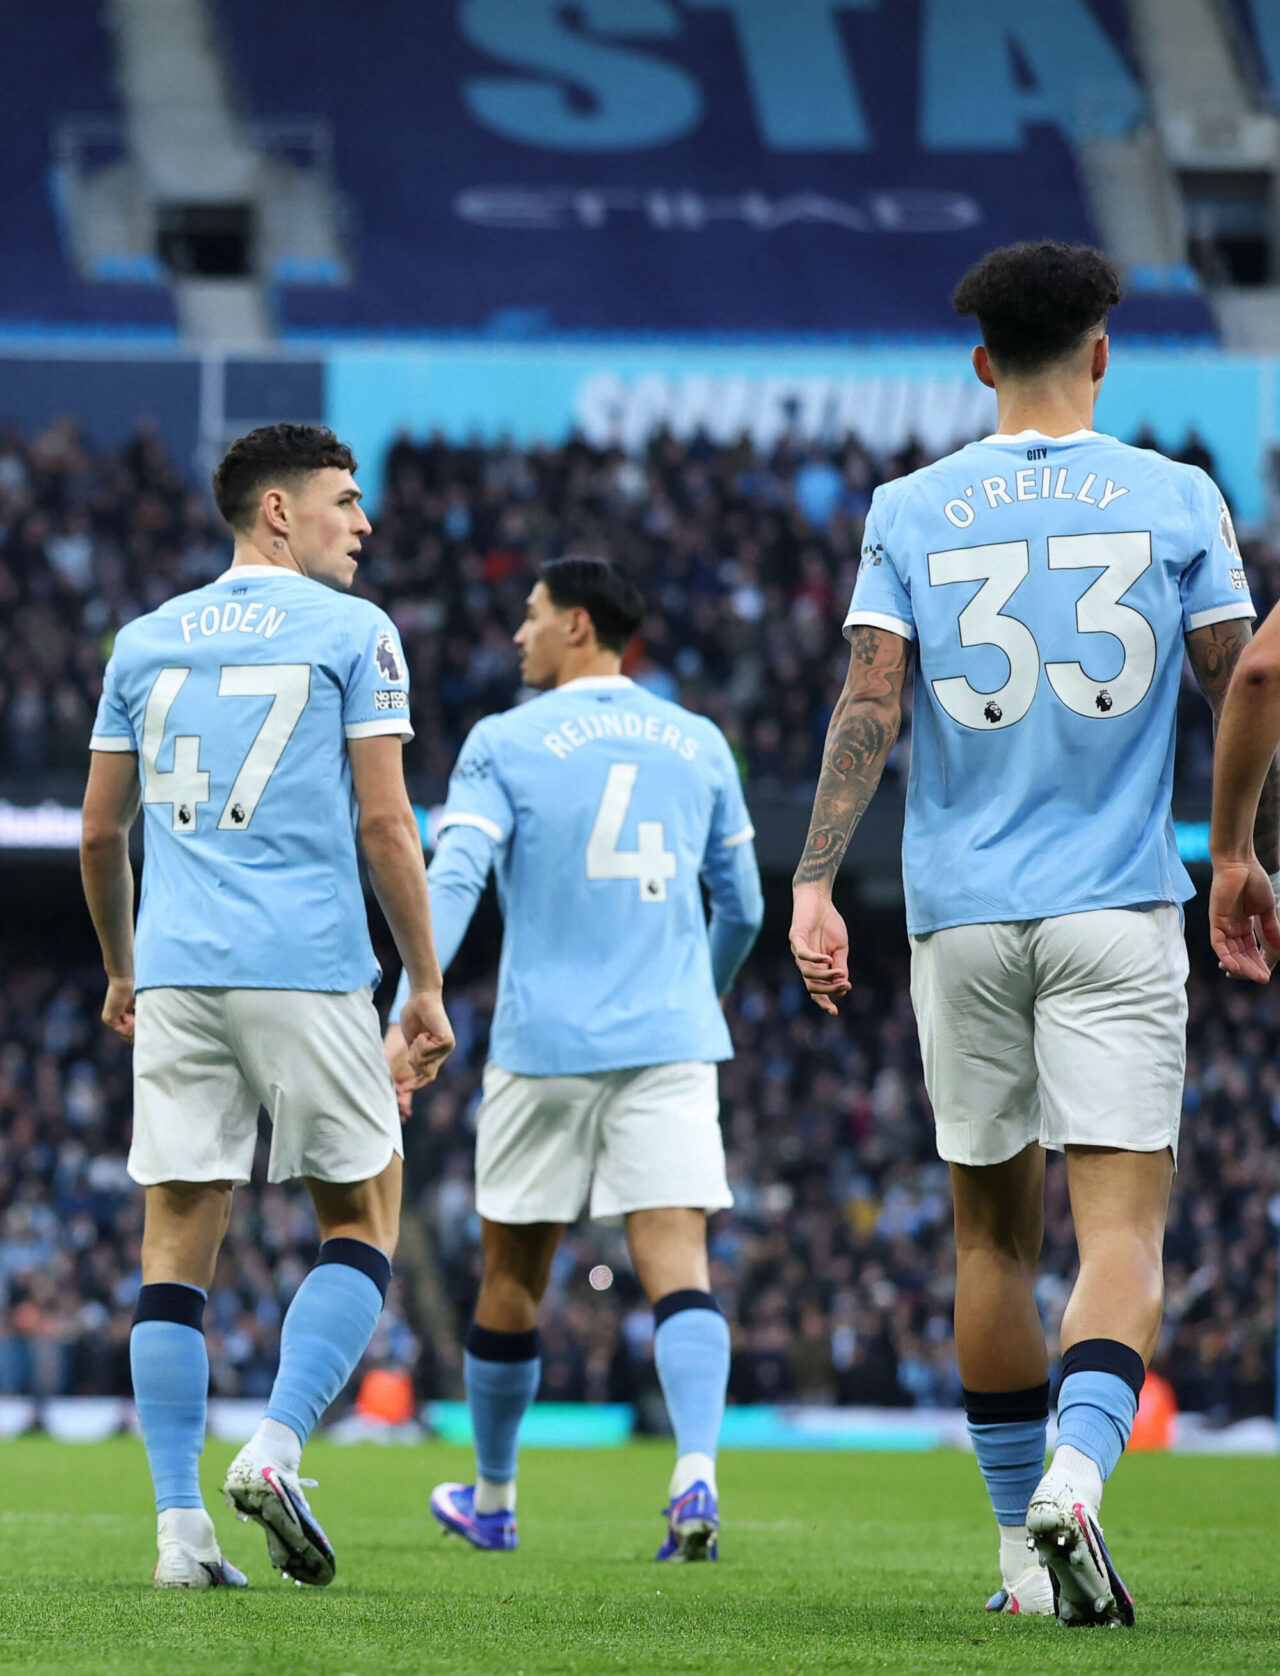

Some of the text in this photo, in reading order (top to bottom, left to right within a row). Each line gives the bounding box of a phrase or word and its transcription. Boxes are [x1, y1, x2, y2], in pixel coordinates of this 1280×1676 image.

[458, 0, 1280, 152] STA
[452, 184, 982, 232] ETIHAD
[943, 466, 1131, 529] O'REILLY
[1026, 447, 1048, 461] CITY
[180, 601, 288, 643] FODEN
[927, 530, 1157, 731] 33
[141, 664, 311, 832] 47
[585, 763, 677, 902] 4
